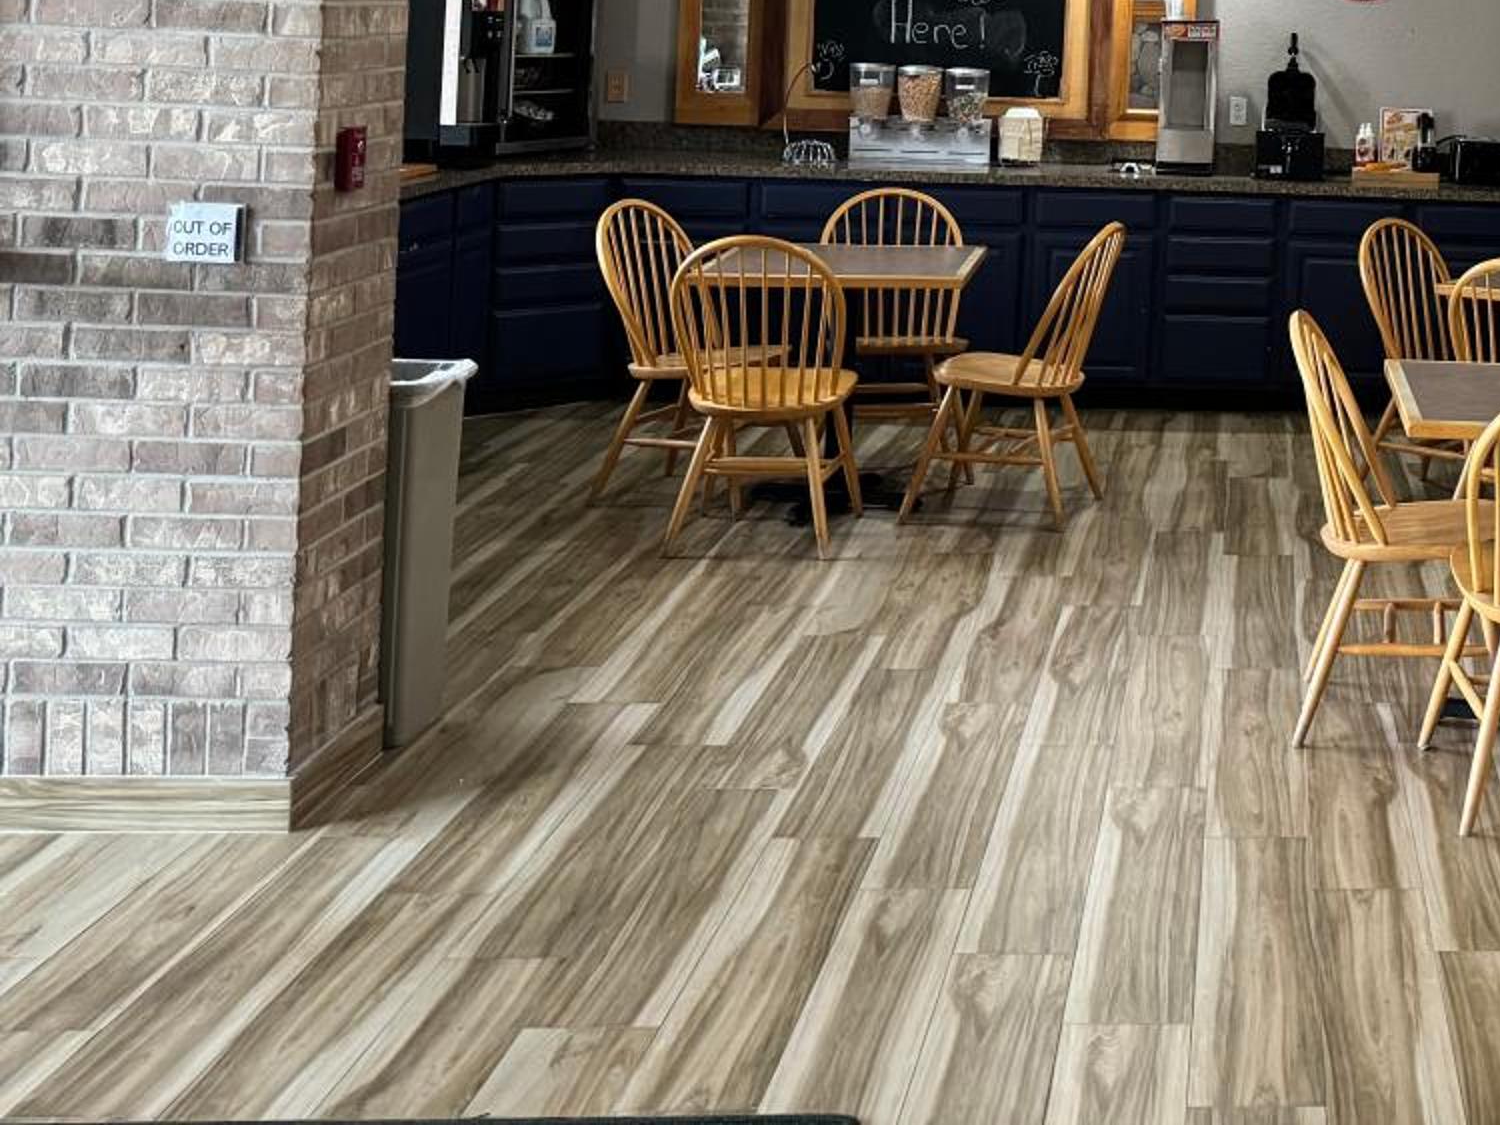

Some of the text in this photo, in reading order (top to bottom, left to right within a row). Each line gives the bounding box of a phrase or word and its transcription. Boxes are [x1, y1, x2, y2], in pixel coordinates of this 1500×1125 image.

[173, 220, 233, 236] OUT OF
[173, 241, 230, 257] ORDER
